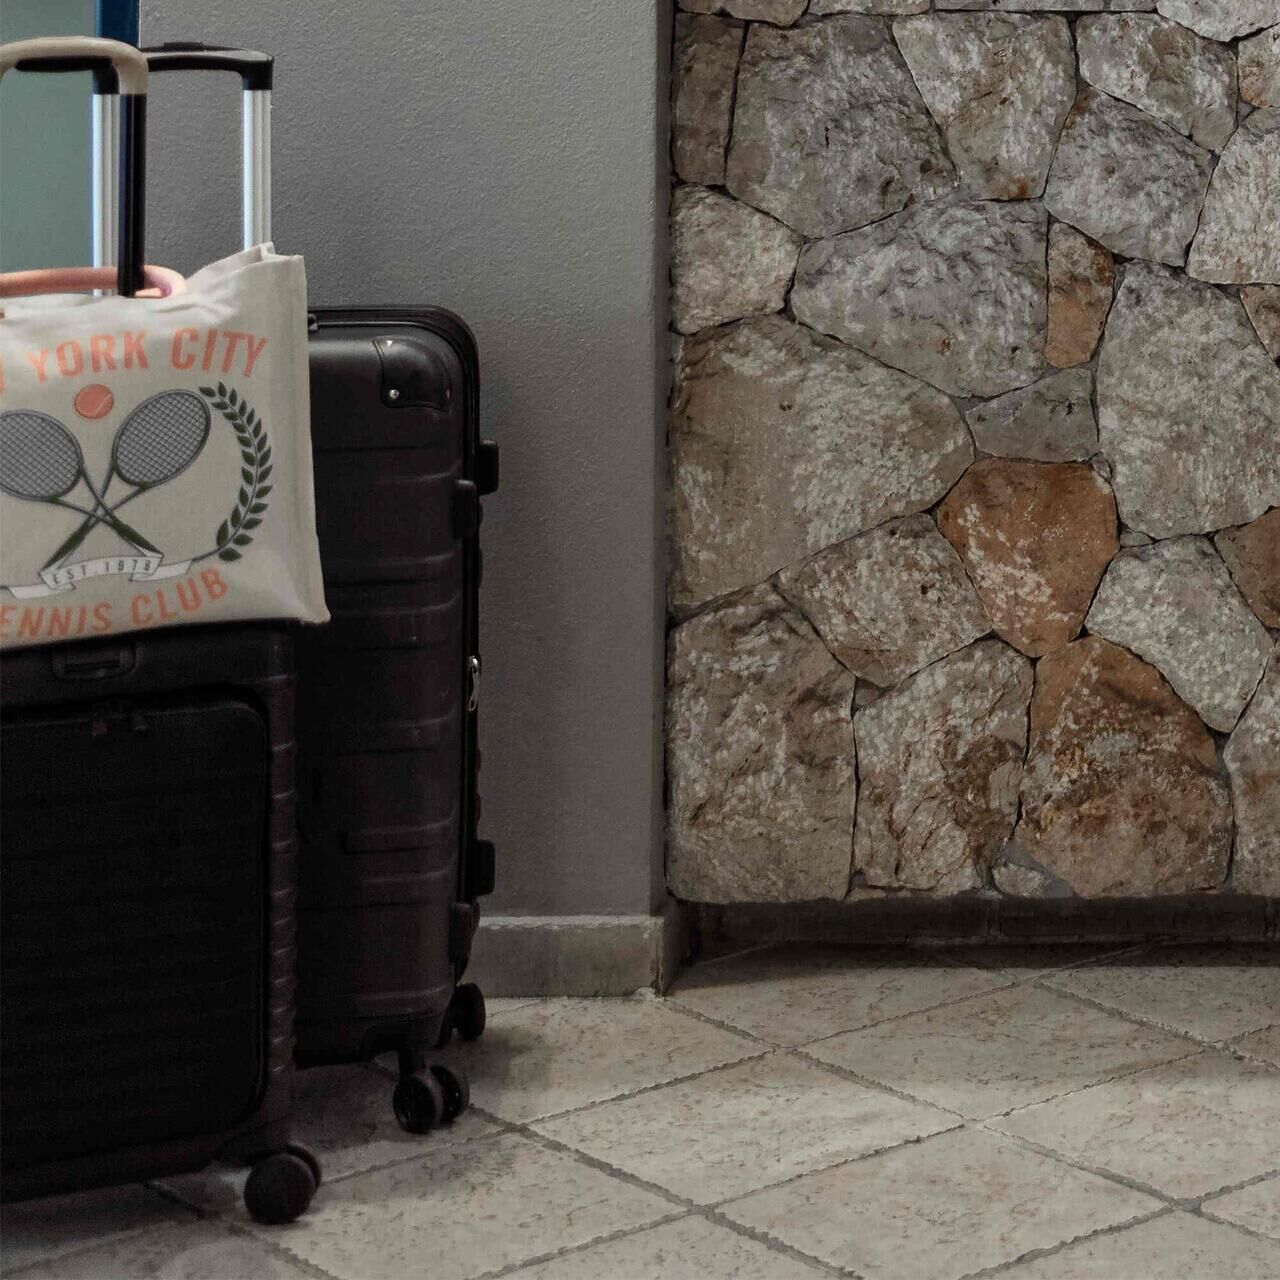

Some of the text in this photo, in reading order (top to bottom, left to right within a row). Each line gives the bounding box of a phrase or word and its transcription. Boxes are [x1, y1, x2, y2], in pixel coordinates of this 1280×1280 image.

[28, 331, 149, 382] YORK
[172, 327, 268, 378] CITY
[105, 560, 151, 572] 1978
[0, 568, 228, 640] ENNIS CLUB
